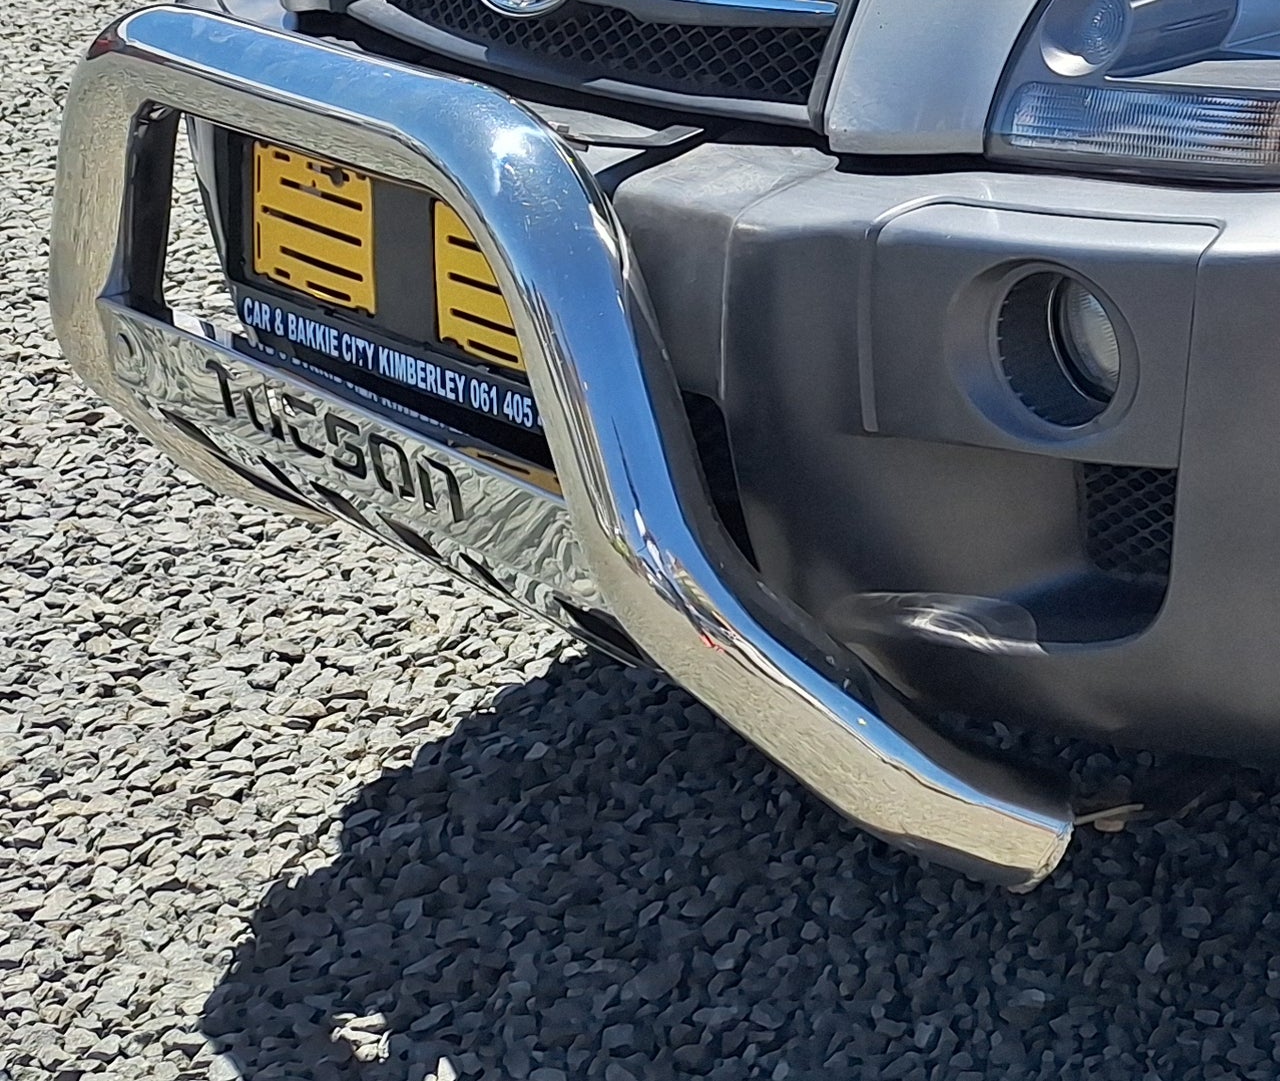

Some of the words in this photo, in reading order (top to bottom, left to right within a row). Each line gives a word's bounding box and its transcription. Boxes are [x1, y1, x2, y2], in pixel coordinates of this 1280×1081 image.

[243, 297, 271, 332] CAR
[274, 308, 285, 337] &
[288, 312, 339, 357] BAKKIE
[341, 332, 375, 371] CITY
[378, 345, 466, 404] KIMBERLEY
[470, 377, 499, 416] 061
[502, 389, 533, 429] 405
